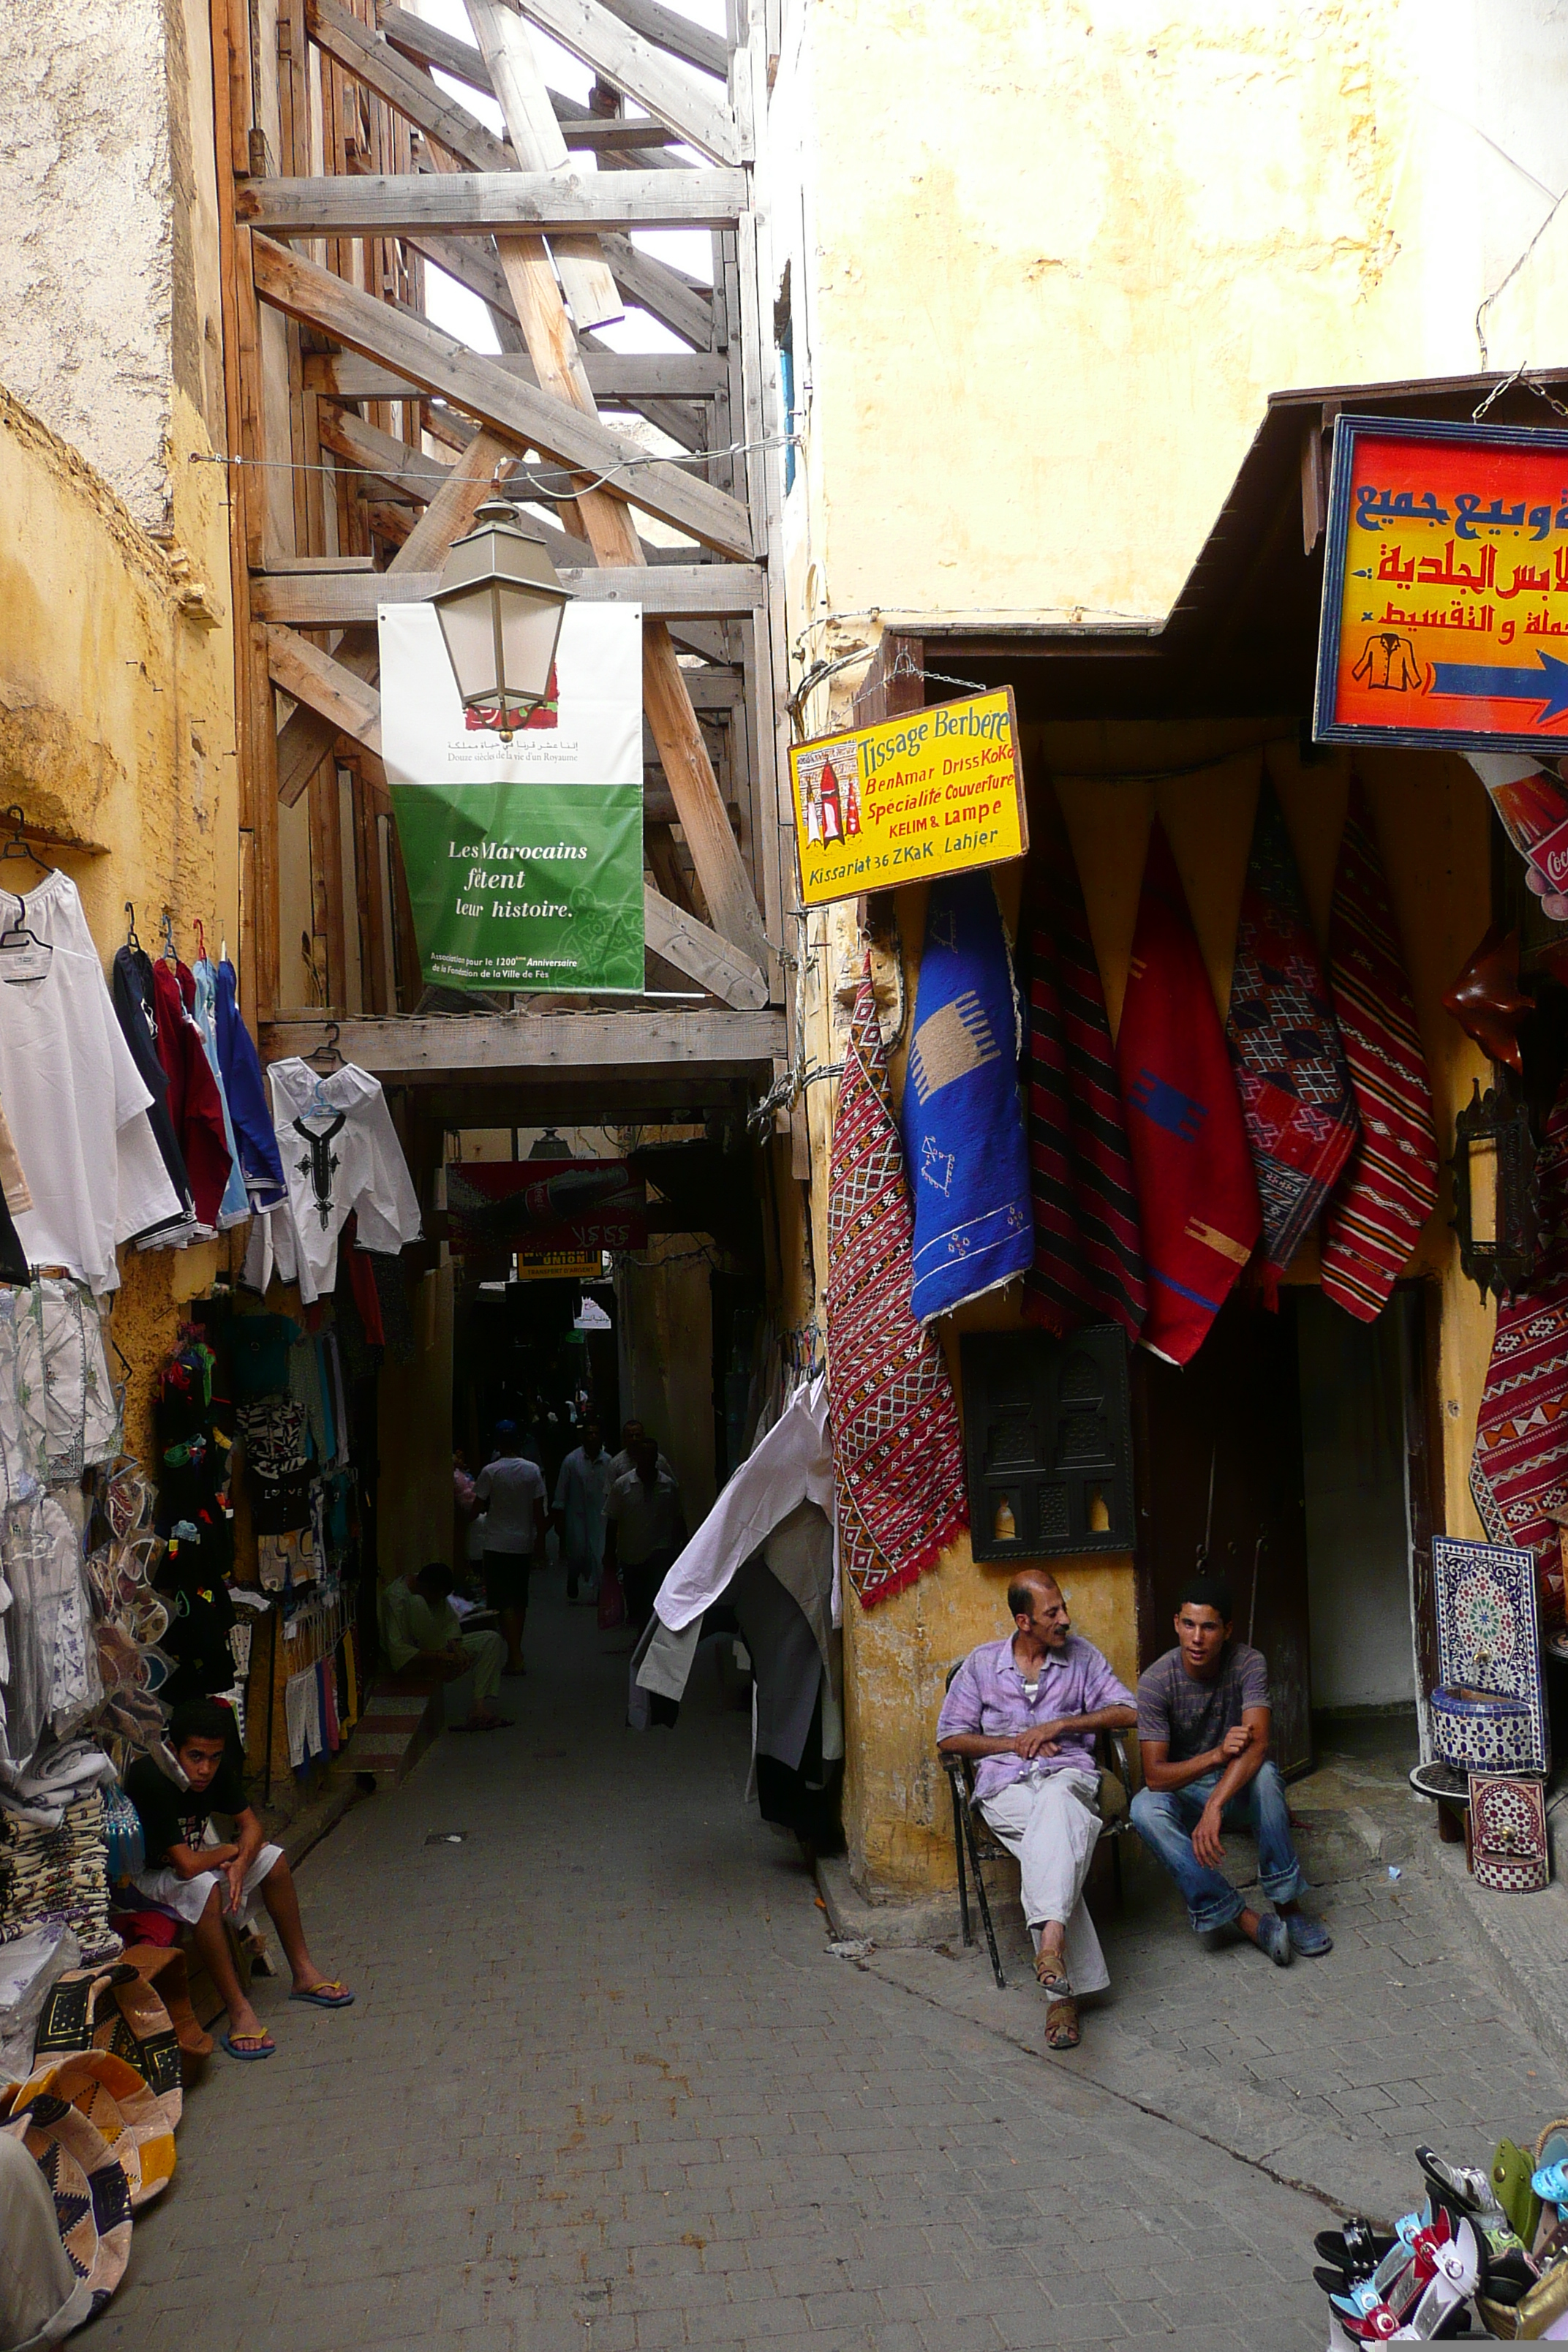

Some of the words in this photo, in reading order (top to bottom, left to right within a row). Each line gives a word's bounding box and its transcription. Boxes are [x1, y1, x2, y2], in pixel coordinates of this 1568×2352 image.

[1356, 486, 1452, 531] جميع
[1454, 493, 1551, 541] وبيع
[1376, 538, 1499, 596] الجلدية
[1377, 601, 1496, 633] التقسيط
[448, 753, 472, 762] Douze
[513, 753, 524, 761] vie
[544, 753, 578, 764] Royaume
[858, 723, 929, 778] Tissage
[945, 772, 1015, 800] Couverture
[889, 815, 927, 839] KELIM
[930, 815, 941, 829] &
[944, 799, 1002, 828] Lampe
[448, 840, 479, 859] Les
[480, 840, 587, 861] Marocains
[464, 867, 526, 891] fêtent
[808, 853, 872, 886] Kissariat
[875, 854, 889, 869] 36
[455, 898, 484, 919] leur
[492, 900, 573, 919] histoire.
[430, 952, 465, 965] Association
[466, 957, 483, 968] pour
[485, 957, 493, 966] le
[527, 957, 578, 968] Anniversaire
[431, 963, 440, 972] de
[441, 964, 447, 973] la
[480, 970, 491, 978] de
[493, 970, 501, 978] la
[502, 970, 520, 979] Ville
[522, 970, 532, 978] de
[535, 969, 549, 979] Fès
[543, 1255, 586, 1264] UNION
